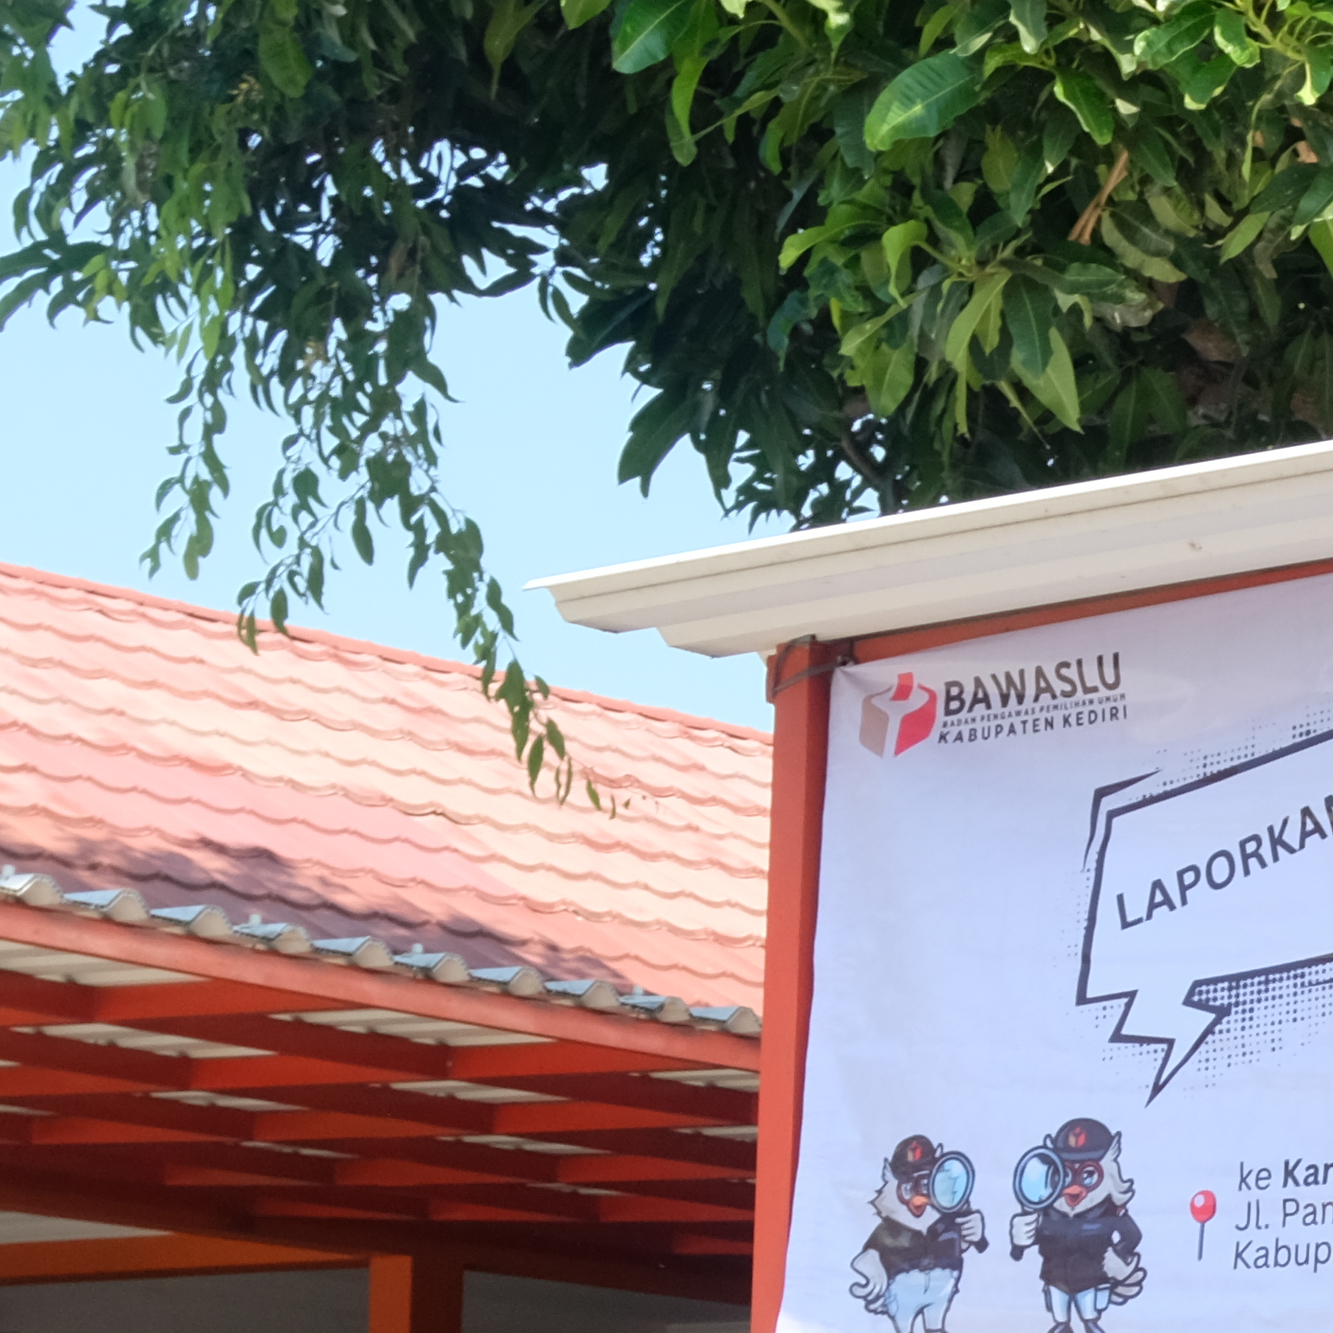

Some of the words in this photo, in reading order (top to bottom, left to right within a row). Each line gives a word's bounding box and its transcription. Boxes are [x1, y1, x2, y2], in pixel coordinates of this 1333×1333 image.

[943, 652, 1122, 717] BAWASLU
[937, 716, 1055, 745] KABUPATEN
[1062, 704, 1128, 729] KEDIRI
[1237, 1161, 1272, 1193] ke
[1234, 1203, 1270, 1233] Jl.
